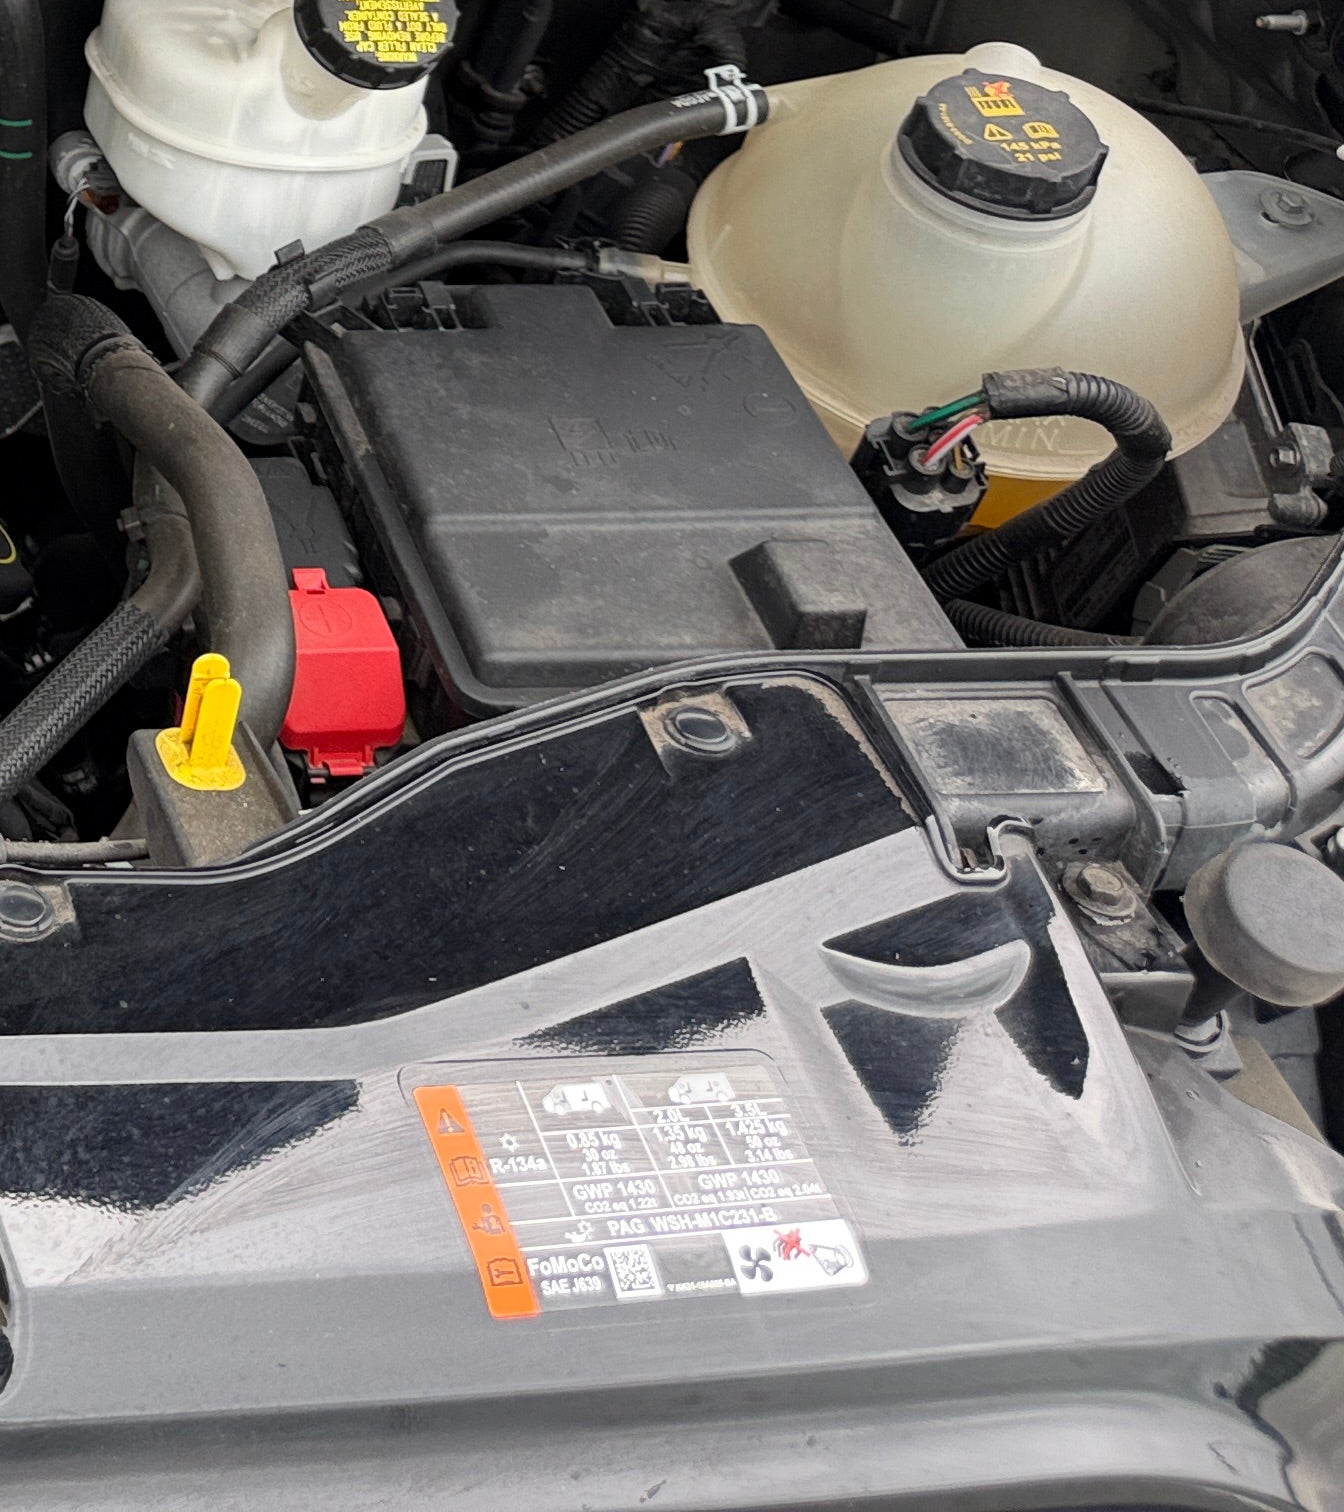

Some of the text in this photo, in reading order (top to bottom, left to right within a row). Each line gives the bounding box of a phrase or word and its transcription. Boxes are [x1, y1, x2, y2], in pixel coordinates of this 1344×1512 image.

[1001, 141, 1061, 152] 145 kPa
[1015, 152, 1061, 163] 21 psi
[653, 1108, 690, 1124] 2.0L
[730, 1103, 768, 1119] 3.5L
[651, 1124, 708, 1143] 1.35 kg
[724, 1117, 788, 1138] 1.425 kg
[566, 1130, 622, 1150] 0.85 kg
[687, 1141, 703, 1154] oz
[745, 1136, 780, 1150] 50 oz
[582, 1148, 619, 1162] 30 oz
[692, 1153, 717, 1168] lbs
[769, 1147, 793, 1161] lbs
[490, 1156, 547, 1174] R-134a
[606, 1159, 630, 1174] lbs
[697, 1169, 780, 1190] GWP 1430
[572, 1179, 657, 1201] GWP 1430
[750, 1186, 775, 1200] CO2
[674, 1192, 699, 1206] CO2
[584, 1201, 608, 1214] CO2
[607, 1215, 646, 1237] PAG
[528, 1255, 604, 1277] FoMoCo
[540, 1275, 602, 1297] SAE J639
